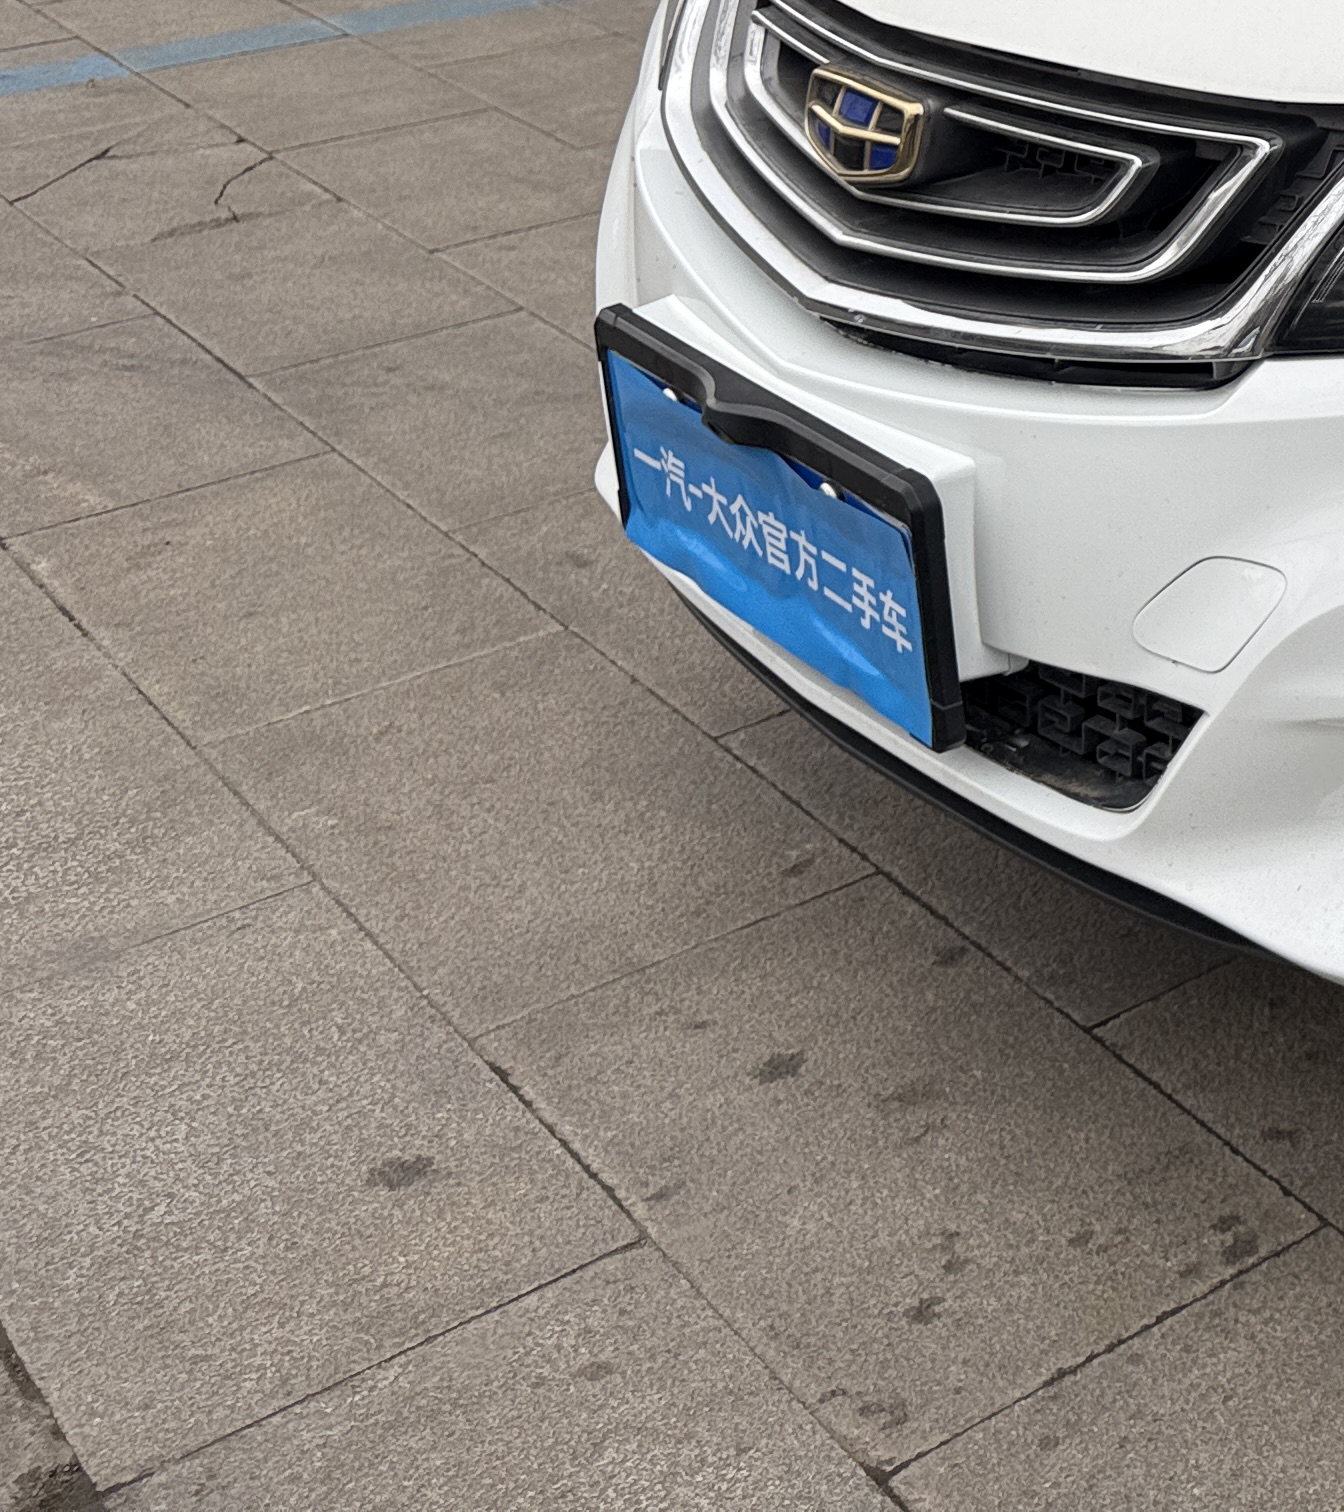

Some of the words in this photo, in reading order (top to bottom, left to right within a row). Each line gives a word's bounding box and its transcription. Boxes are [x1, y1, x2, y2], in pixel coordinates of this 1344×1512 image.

[633, 445, 912, 653] 一汽-大众官方二手车
